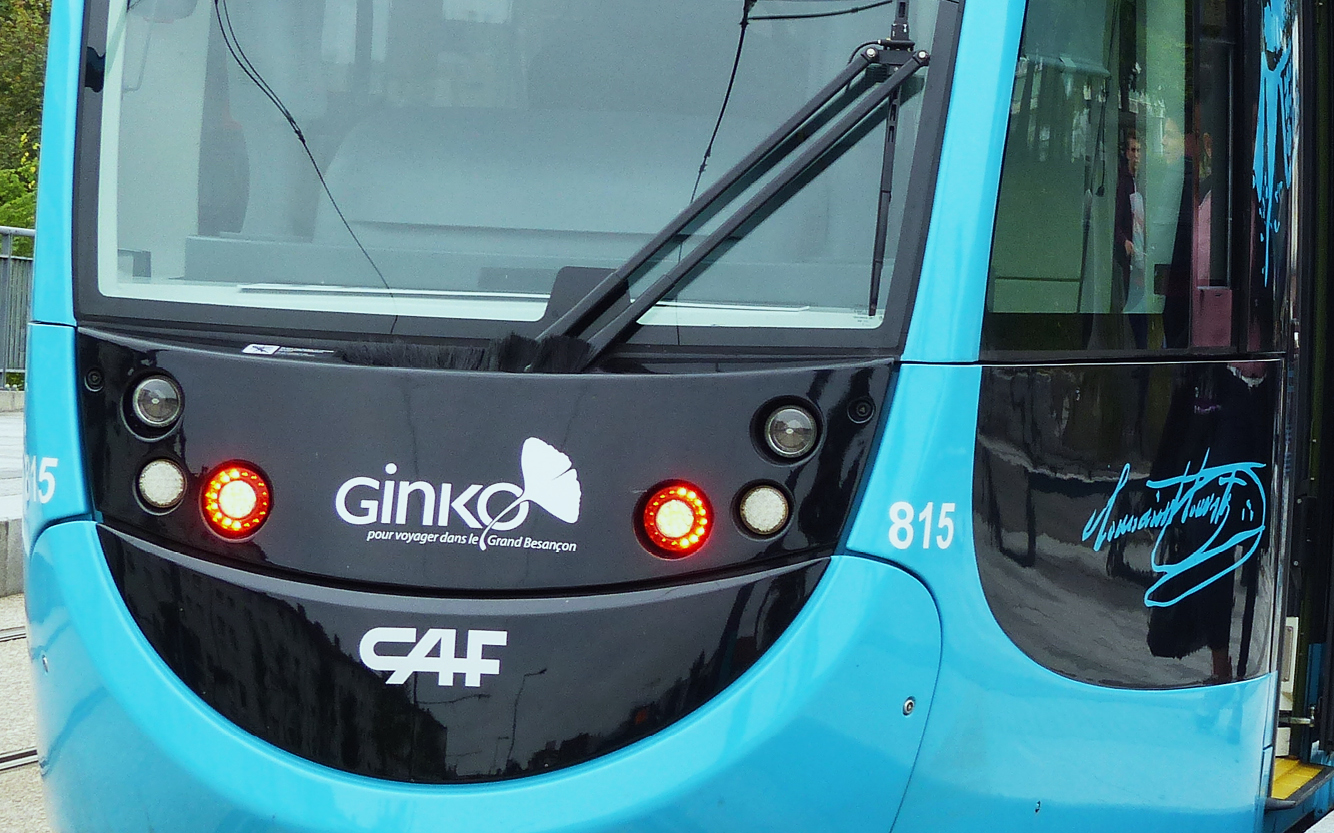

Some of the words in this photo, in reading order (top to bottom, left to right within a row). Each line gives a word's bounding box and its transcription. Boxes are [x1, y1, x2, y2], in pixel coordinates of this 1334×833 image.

[367, 530, 394, 542] pour
[395, 531, 439, 544] voyager
[439, 532, 466, 544] dans
[468, 534, 478, 545] le
[487, 534, 521, 548] Grand
[523, 537, 577, 553] Besançon
[888, 501, 956, 549] 815
[359, 626, 508, 687] CAF
